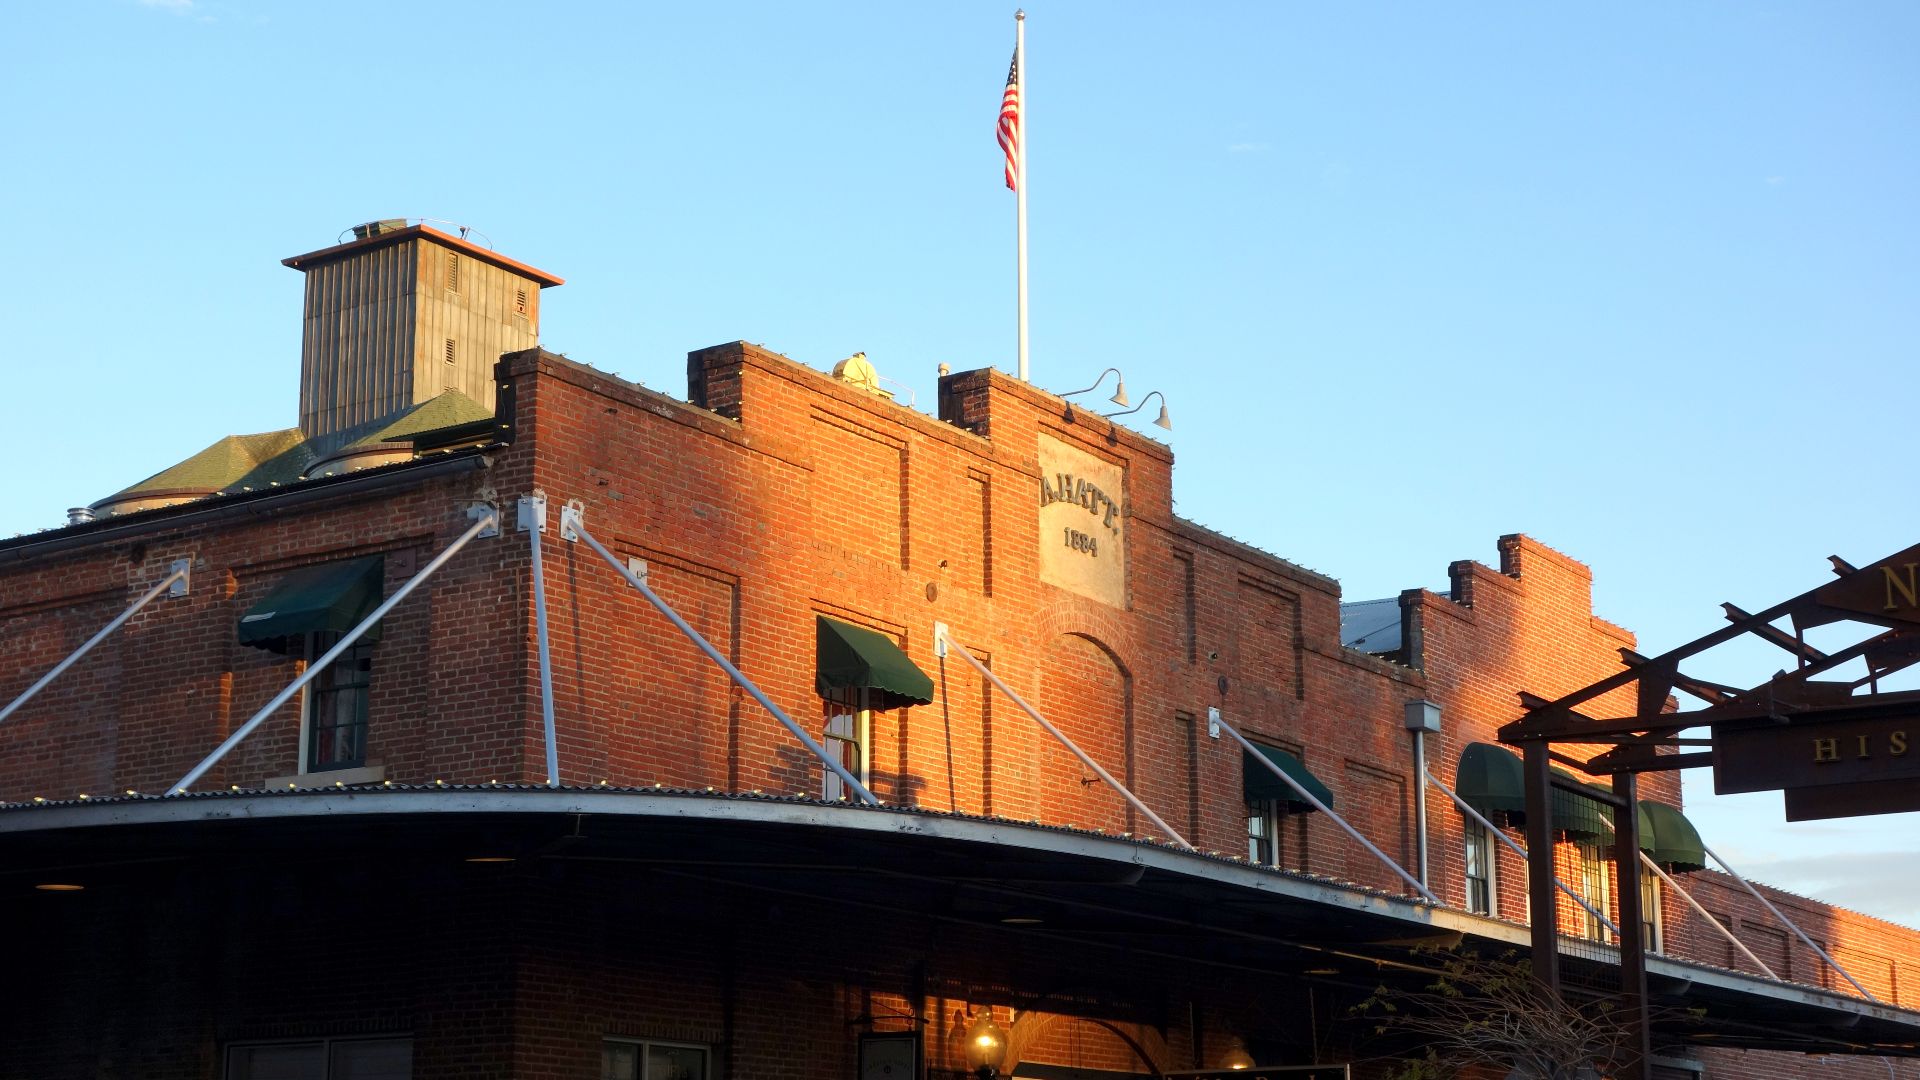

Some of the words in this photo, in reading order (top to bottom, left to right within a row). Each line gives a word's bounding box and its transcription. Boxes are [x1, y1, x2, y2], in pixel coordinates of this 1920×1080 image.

[1064, 526, 1098, 557] 1884
[1879, 562, 1919, 610] N
[1813, 730, 1908, 763] HIS
